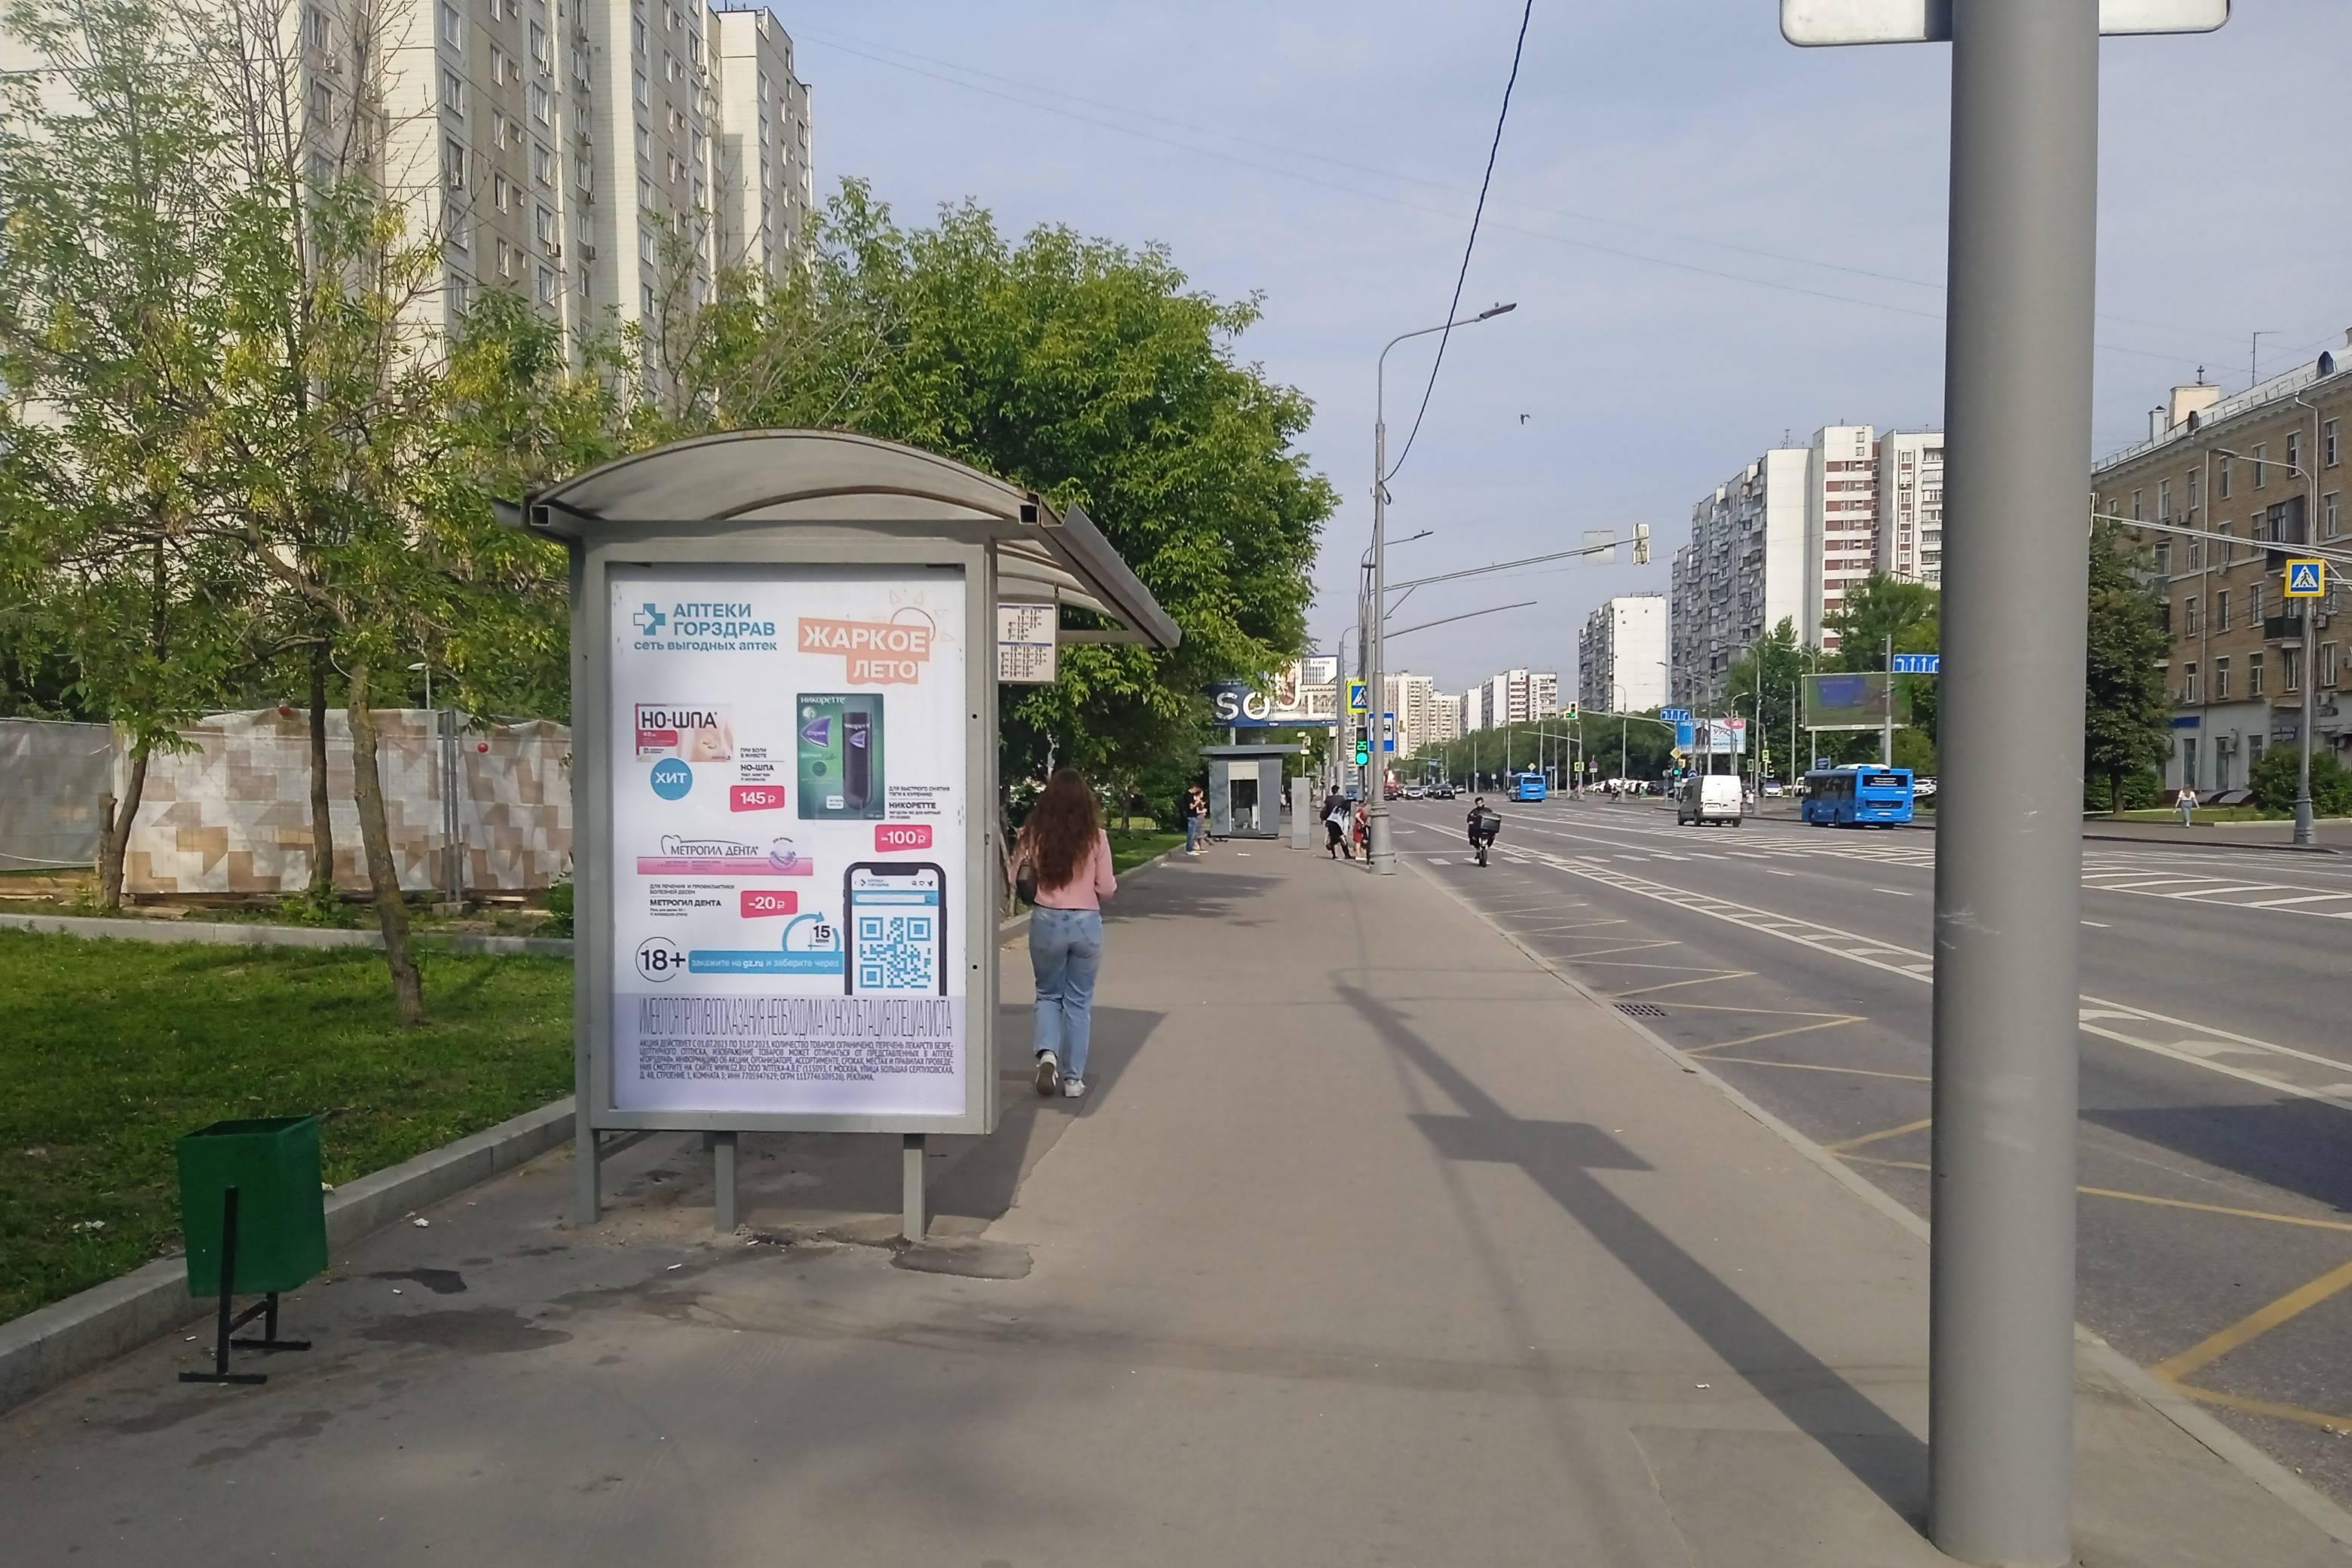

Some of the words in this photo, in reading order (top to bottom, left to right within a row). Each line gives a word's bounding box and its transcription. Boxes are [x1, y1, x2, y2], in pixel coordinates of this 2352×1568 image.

[673, 603, 752, 618] АПТЕКИ
[673, 621, 776, 639] ГОРЗДРАВ
[634, 642, 664, 651] сеть
[667, 641, 736, 652] выгодных
[739, 642, 777, 651] аптек
[803, 625, 926, 654] ЖАРКОЕ
[853, 659, 917, 679] ЛЕТО
[655, 772, 688, 784] ХИТ
[671, 845, 722, 856] МЕТРОГИЛ
[813, 925, 830, 939] 15
[640, 948, 686, 971] 18+
[691, 959, 730, 967] закажите
[743, 960, 764, 969] gz.ru
[773, 958, 813, 968] заберите
[814, 960, 839, 968] через
